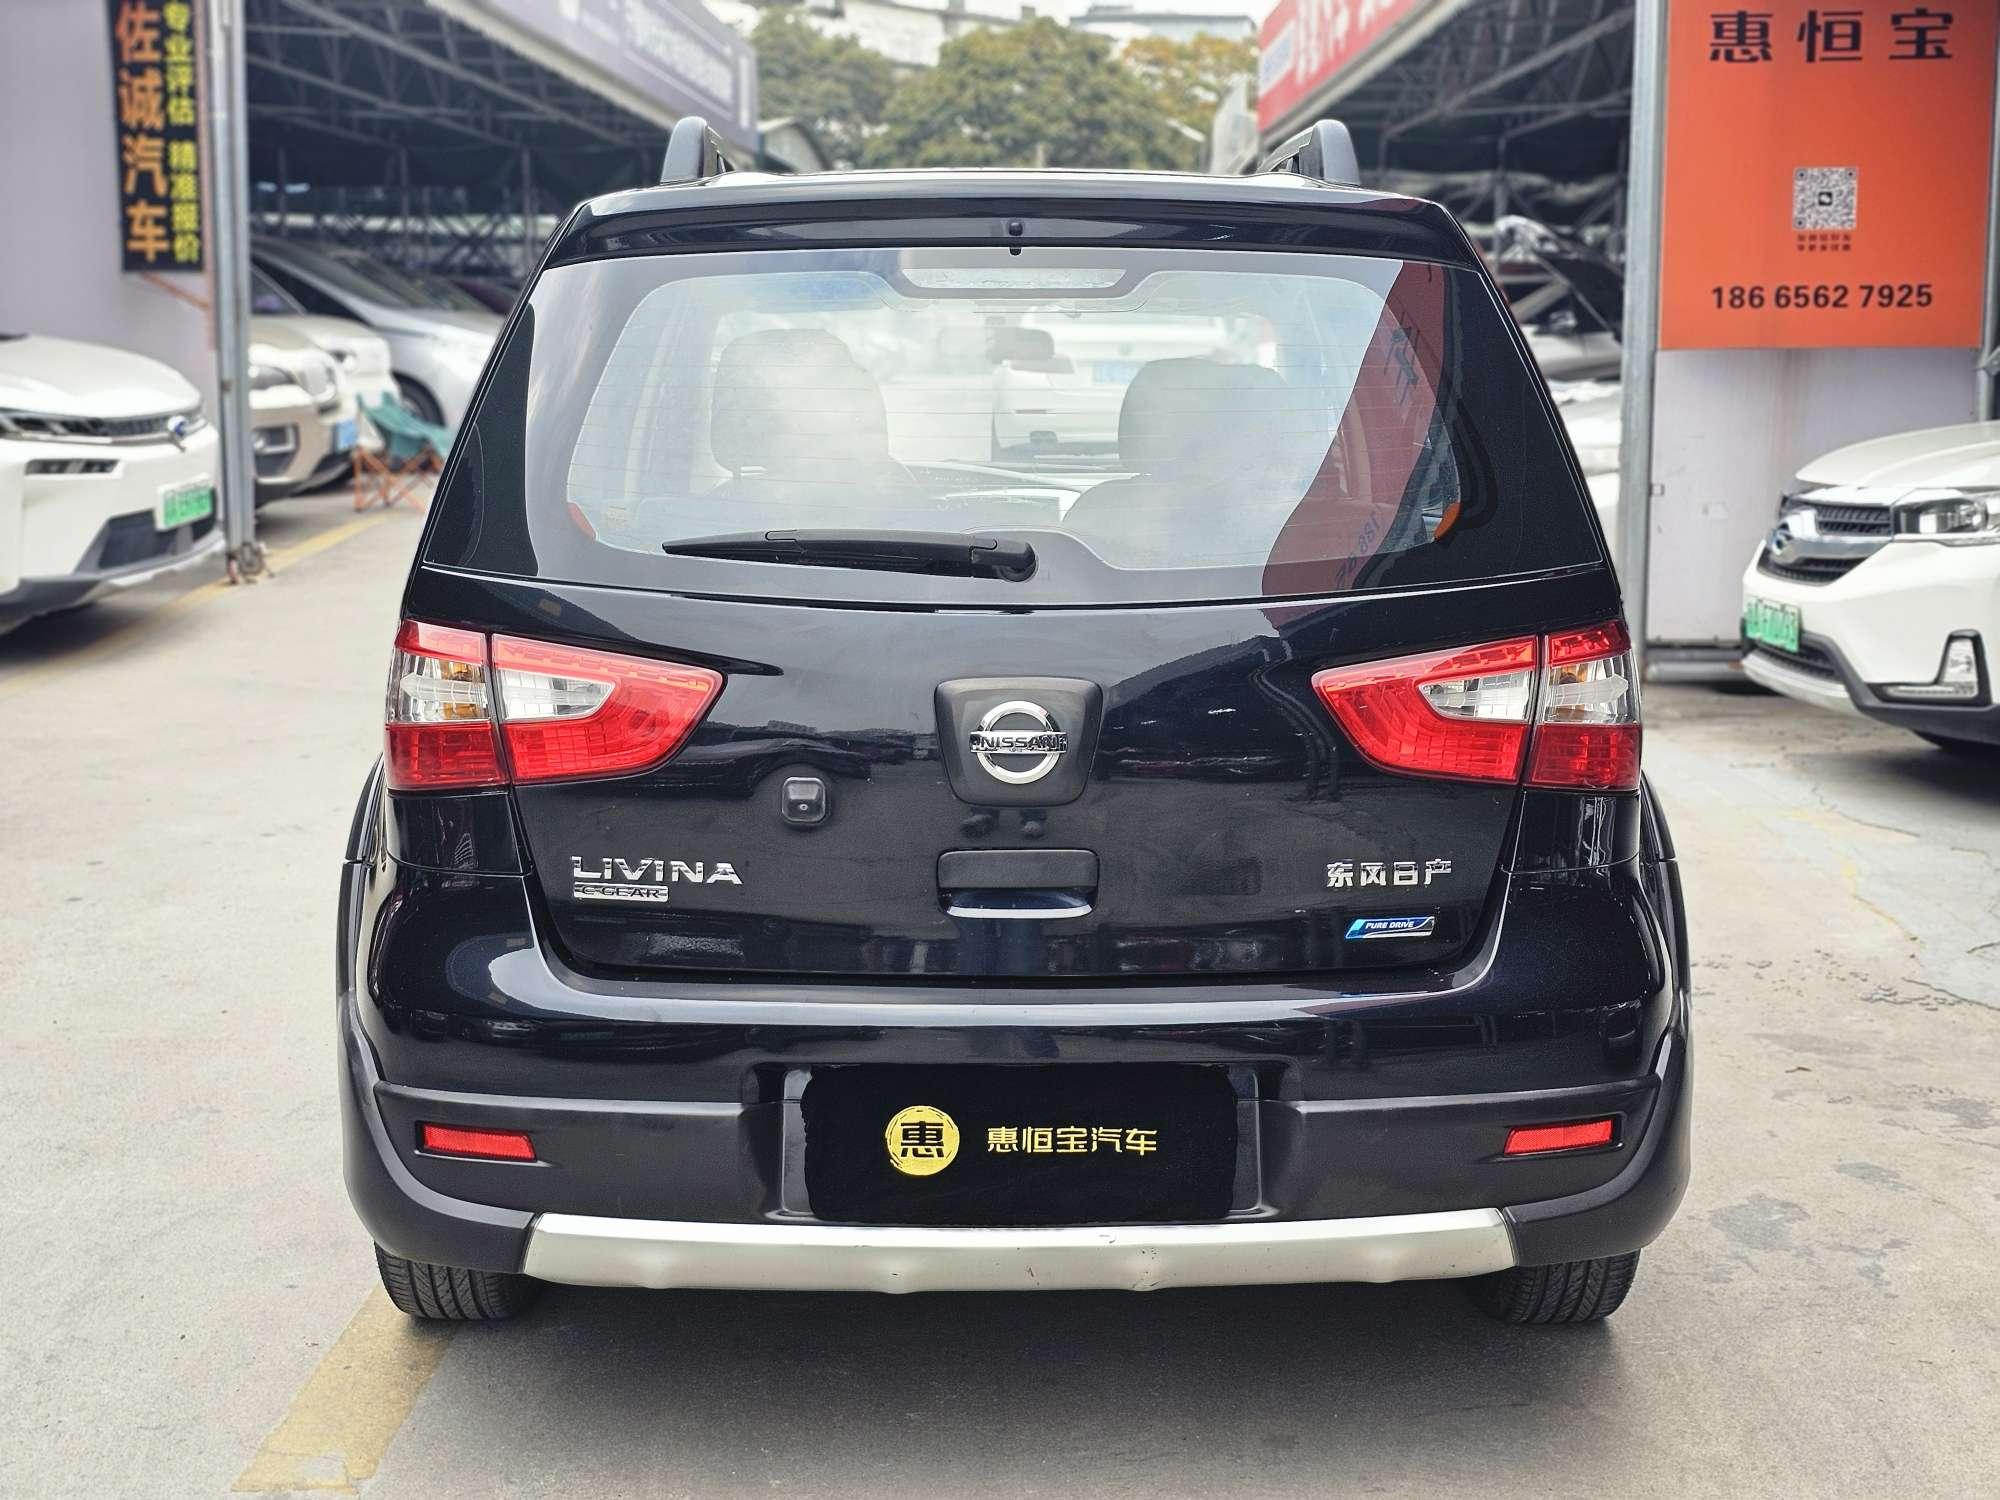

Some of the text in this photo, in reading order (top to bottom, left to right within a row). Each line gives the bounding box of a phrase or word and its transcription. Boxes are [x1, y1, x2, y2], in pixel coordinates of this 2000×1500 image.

[1709, 7, 1954, 63] 惠恒宝
[1711, 284, 1933, 308] 186 6562 7925
[980, 735, 1060, 749] NISSAN
[571, 855, 743, 885] LIVINA
[1326, 858, 1452, 888] 东风日产
[1389, 920, 1415, 929] DRIVE
